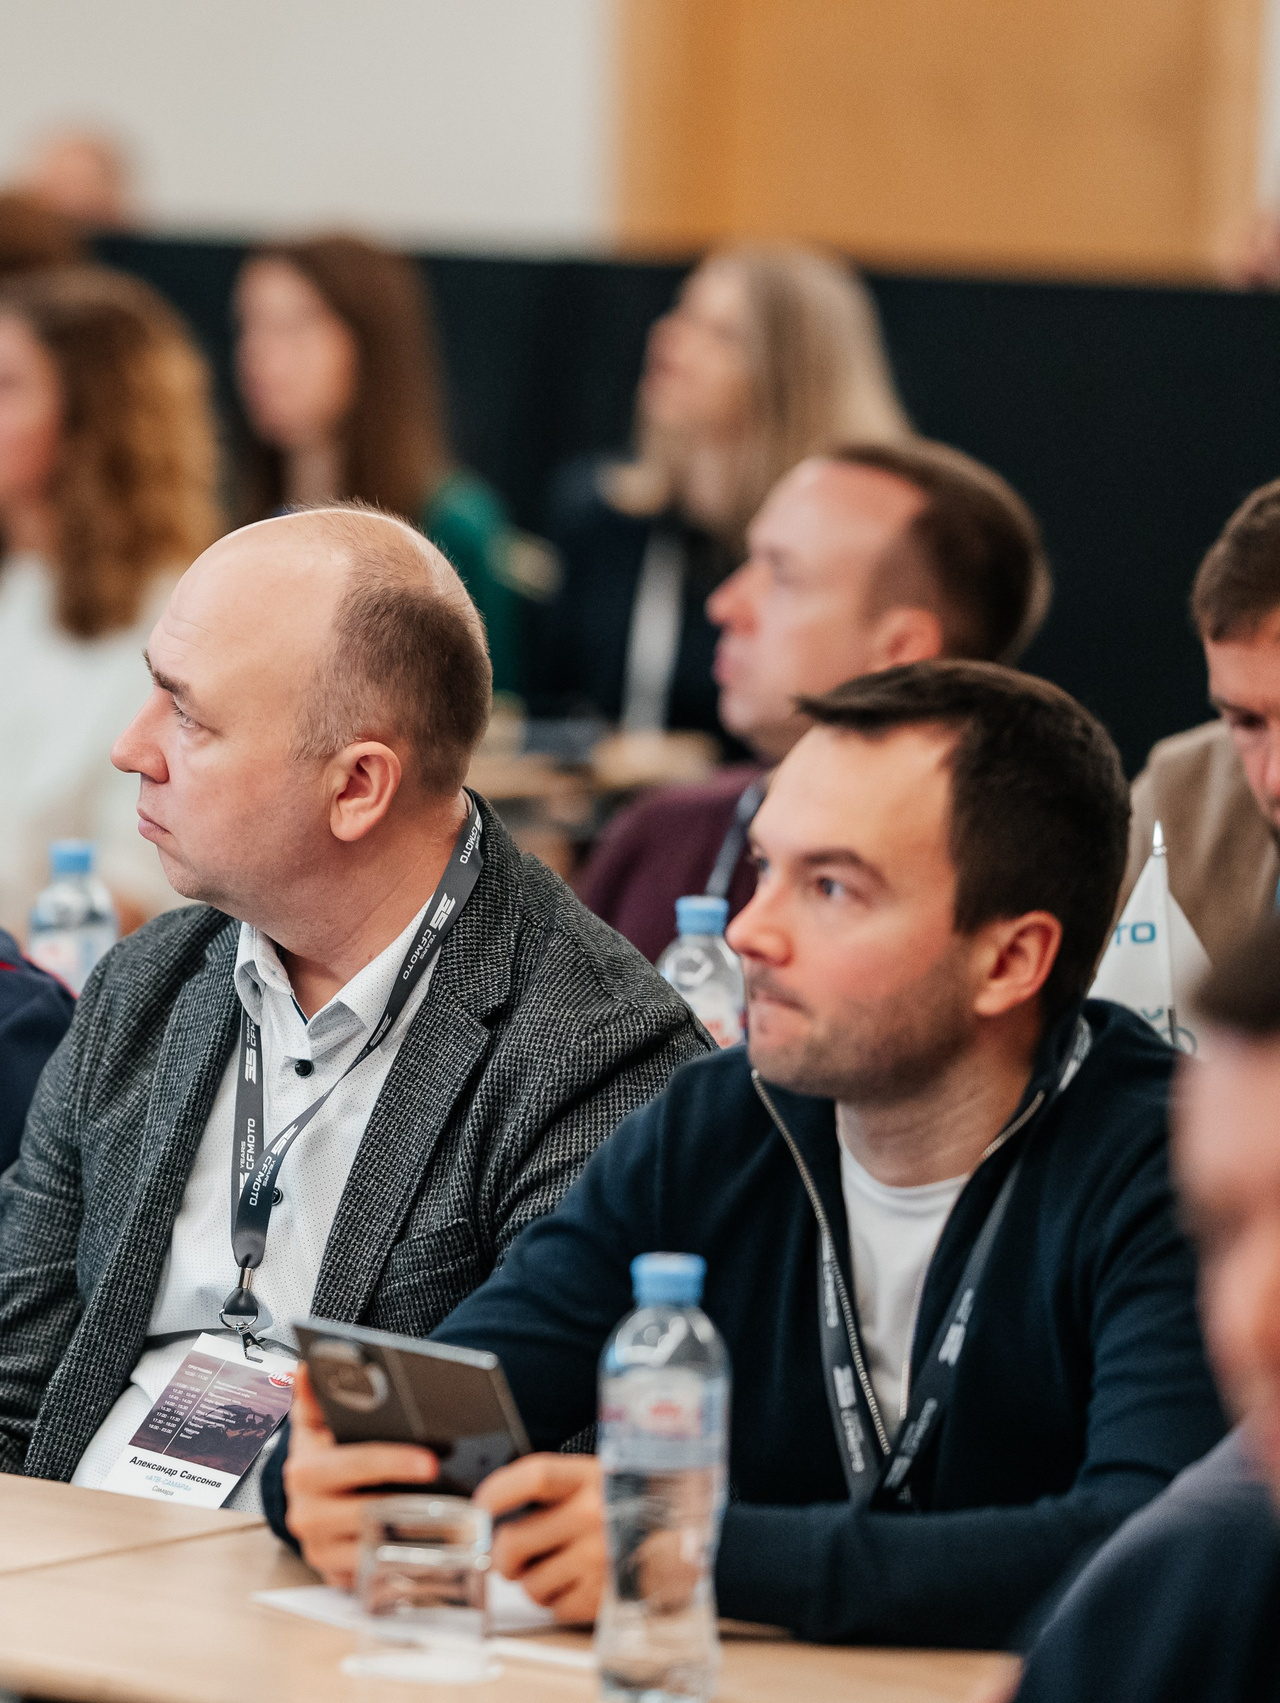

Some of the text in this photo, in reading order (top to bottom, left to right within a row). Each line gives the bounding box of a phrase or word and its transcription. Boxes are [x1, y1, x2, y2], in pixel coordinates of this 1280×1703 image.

[460, 826, 478, 864] CFMOTO
[402, 929, 432, 980] CFMOTO
[420, 934, 437, 960] YEARS
[246, 1117, 256, 1170] CFMOTO
[249, 1155, 272, 1206] CFMOTO
[262, 1160, 276, 1187] YEARS
[129, 1456, 222, 1488] Александр Саксонов
[151, 1485, 174, 1496] Самара
